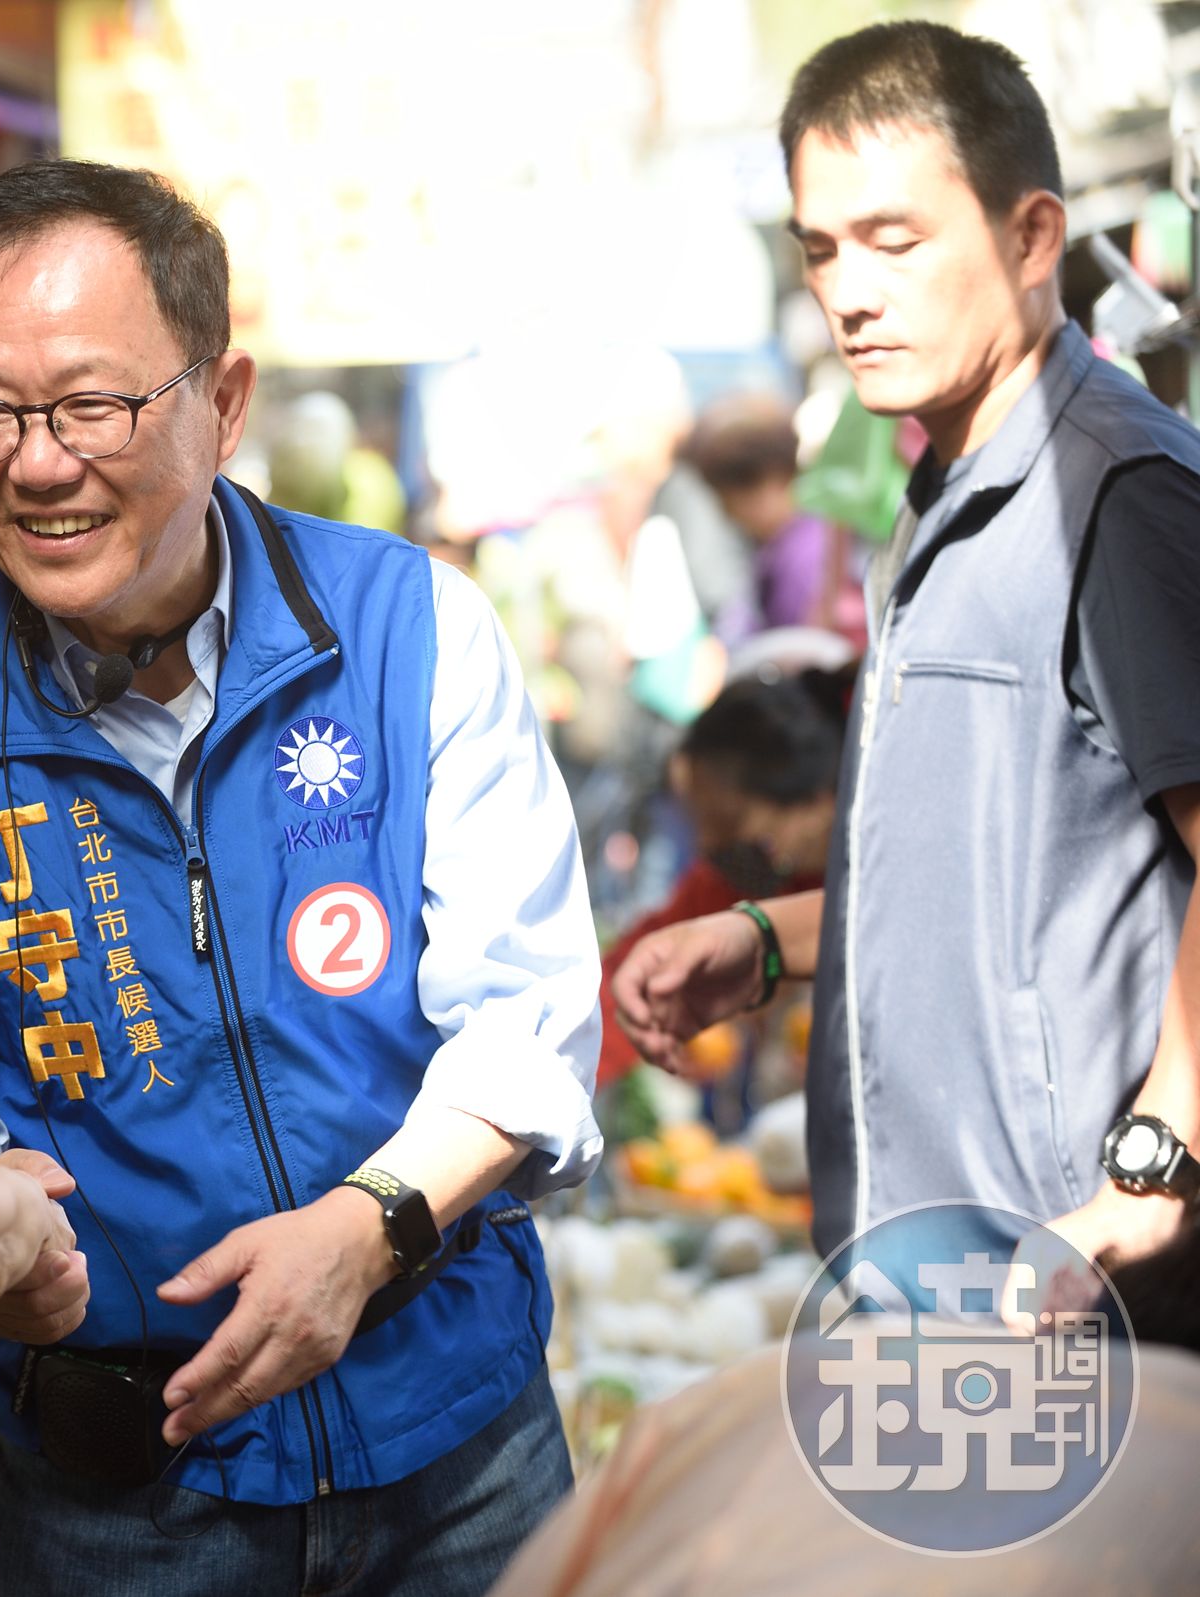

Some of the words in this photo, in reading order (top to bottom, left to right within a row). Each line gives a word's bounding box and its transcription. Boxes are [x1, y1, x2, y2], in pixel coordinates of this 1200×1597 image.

[282, 810, 375, 854] KMT
[68, 797, 175, 1093] 台北市市長候選人
[191, 879, 207, 951] MENSHARK
[319, 903, 364, 975] 2
